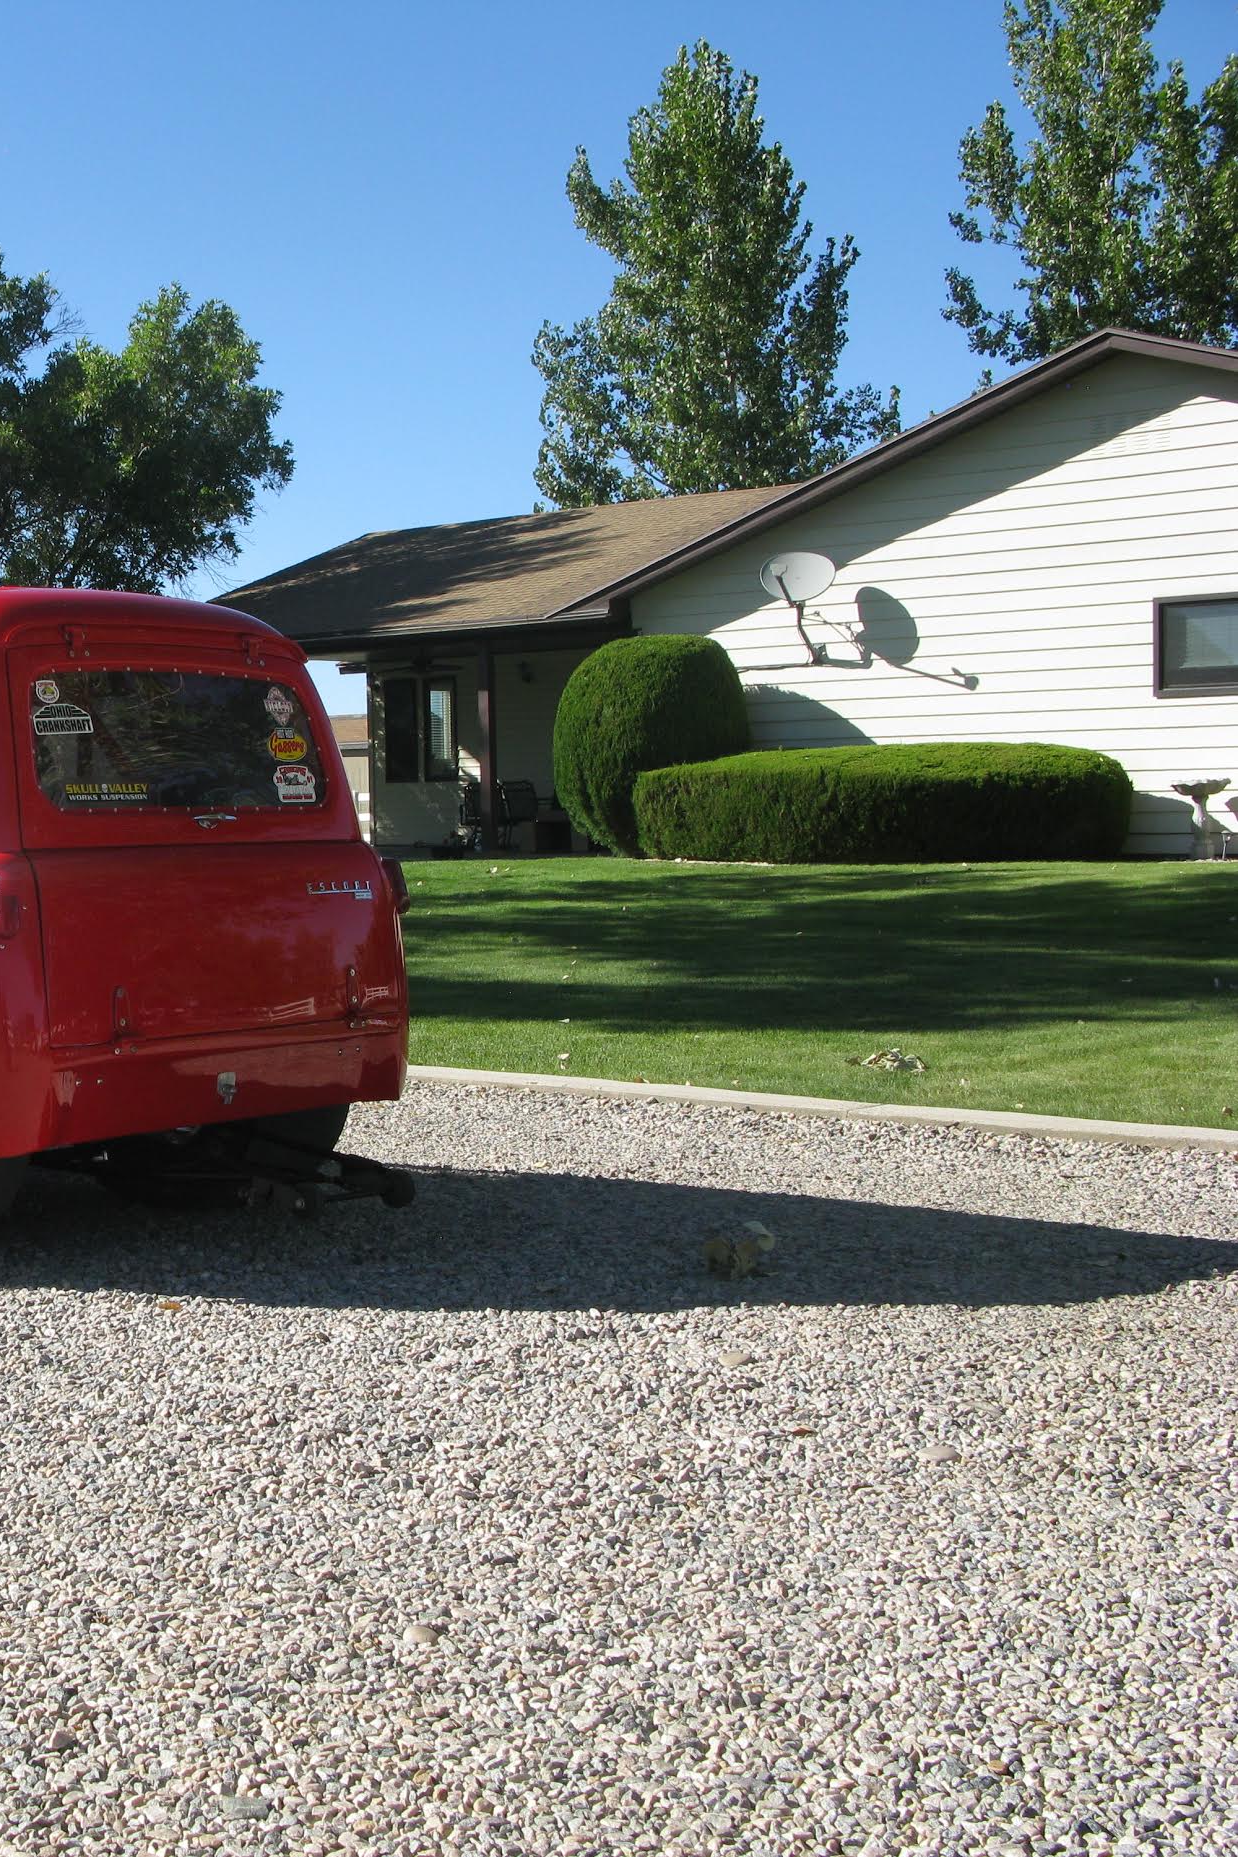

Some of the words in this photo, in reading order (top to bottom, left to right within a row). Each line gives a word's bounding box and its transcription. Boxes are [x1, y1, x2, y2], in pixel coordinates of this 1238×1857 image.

[50, 705, 73, 719] OHIO
[35, 719, 92, 733] CRANKSHAFT
[65, 783, 102, 794] SKULL
[107, 783, 149, 794] VALLEY
[100, 793, 149, 801] SUSPENSION
[306, 880, 371, 896] ESCORT
